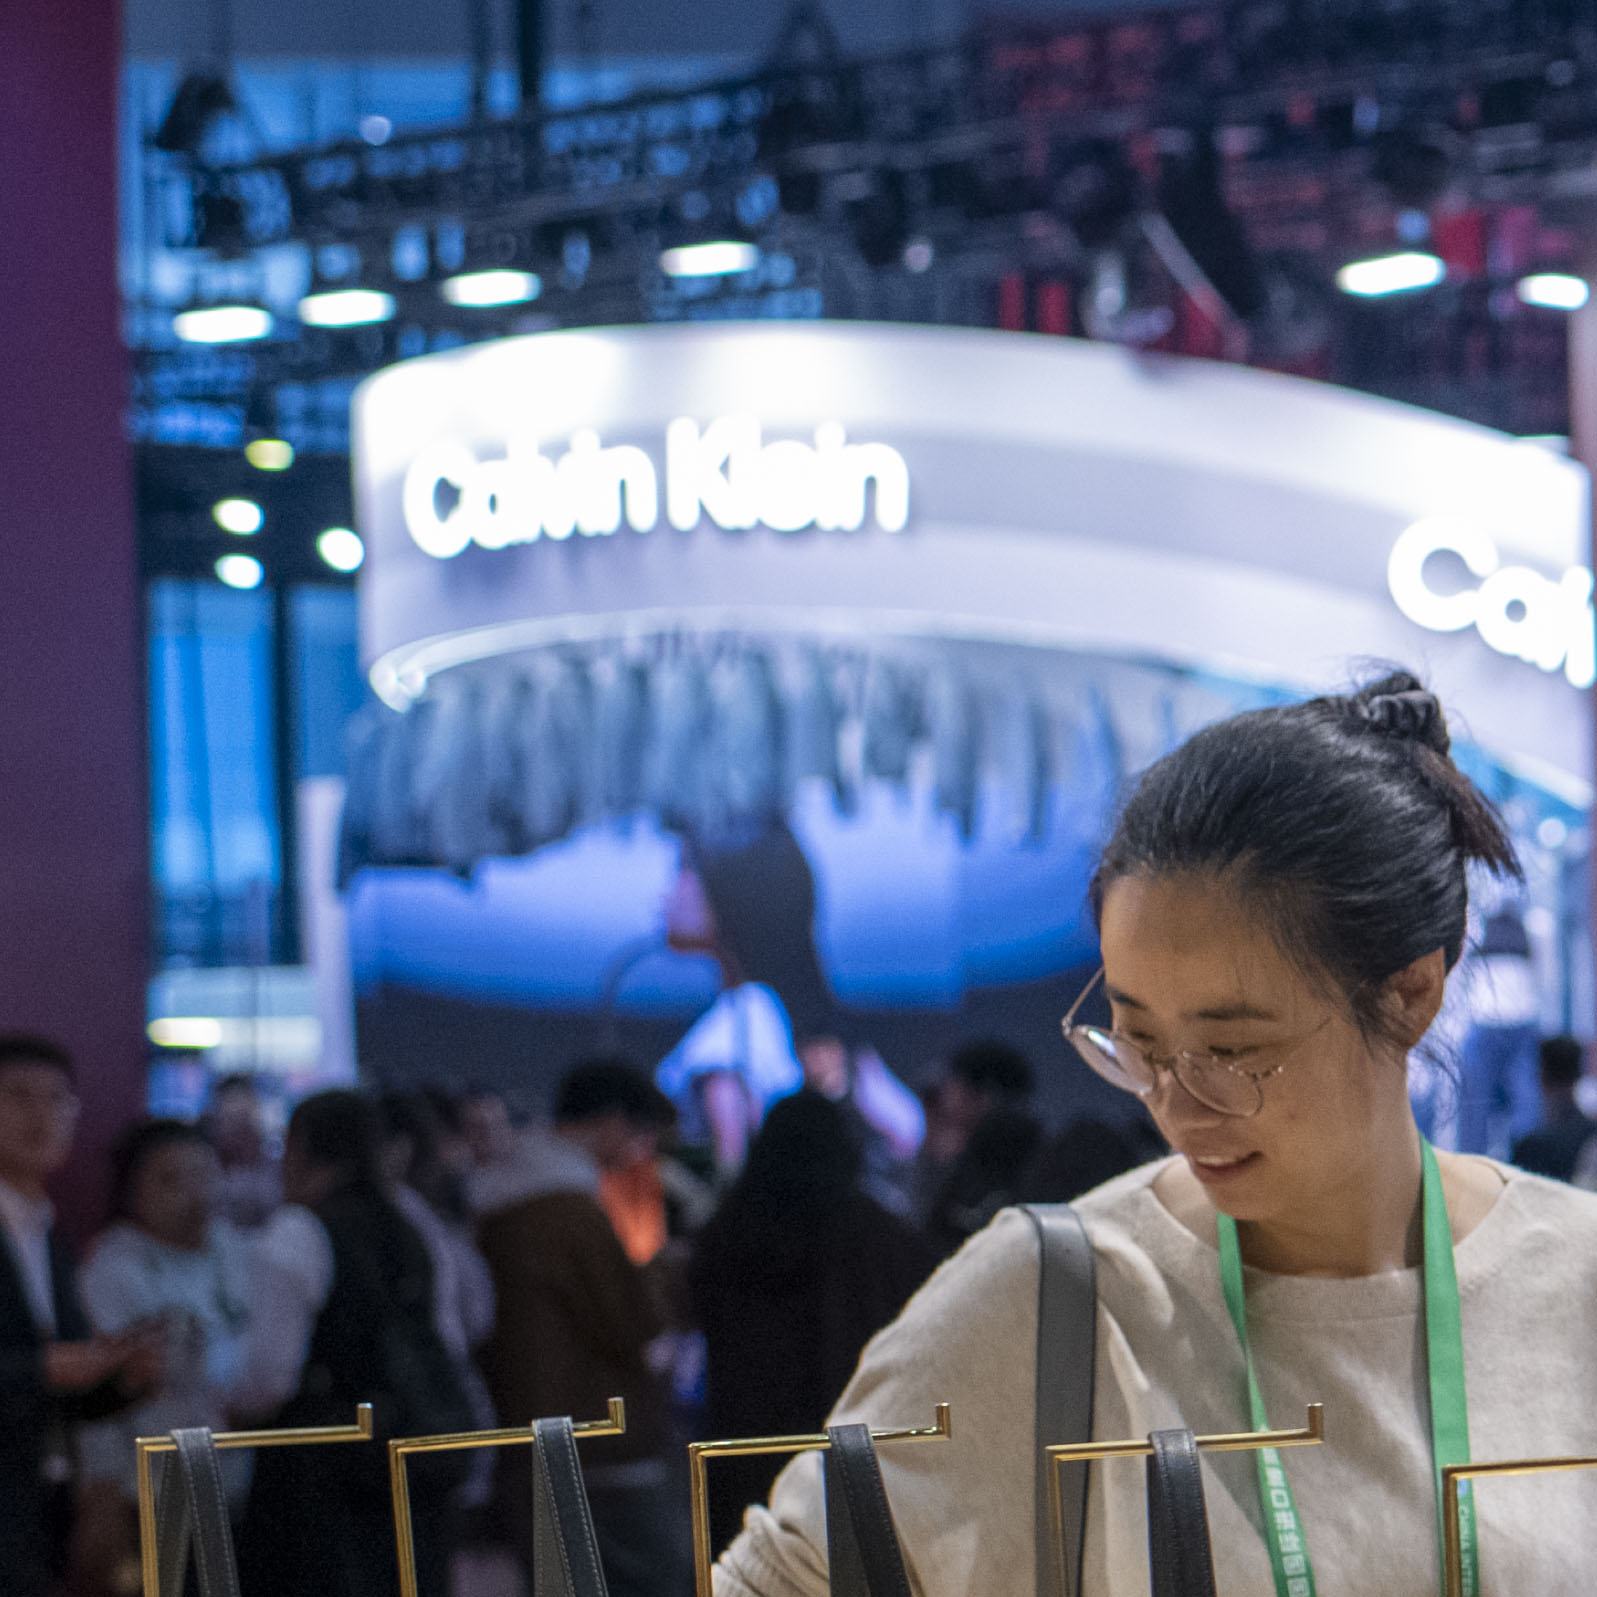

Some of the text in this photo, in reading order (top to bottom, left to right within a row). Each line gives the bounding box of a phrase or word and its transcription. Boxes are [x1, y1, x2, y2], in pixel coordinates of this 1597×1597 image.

[403, 415, 909, 559] Calvin Klein
[1388, 516, 1597, 690] Cal
